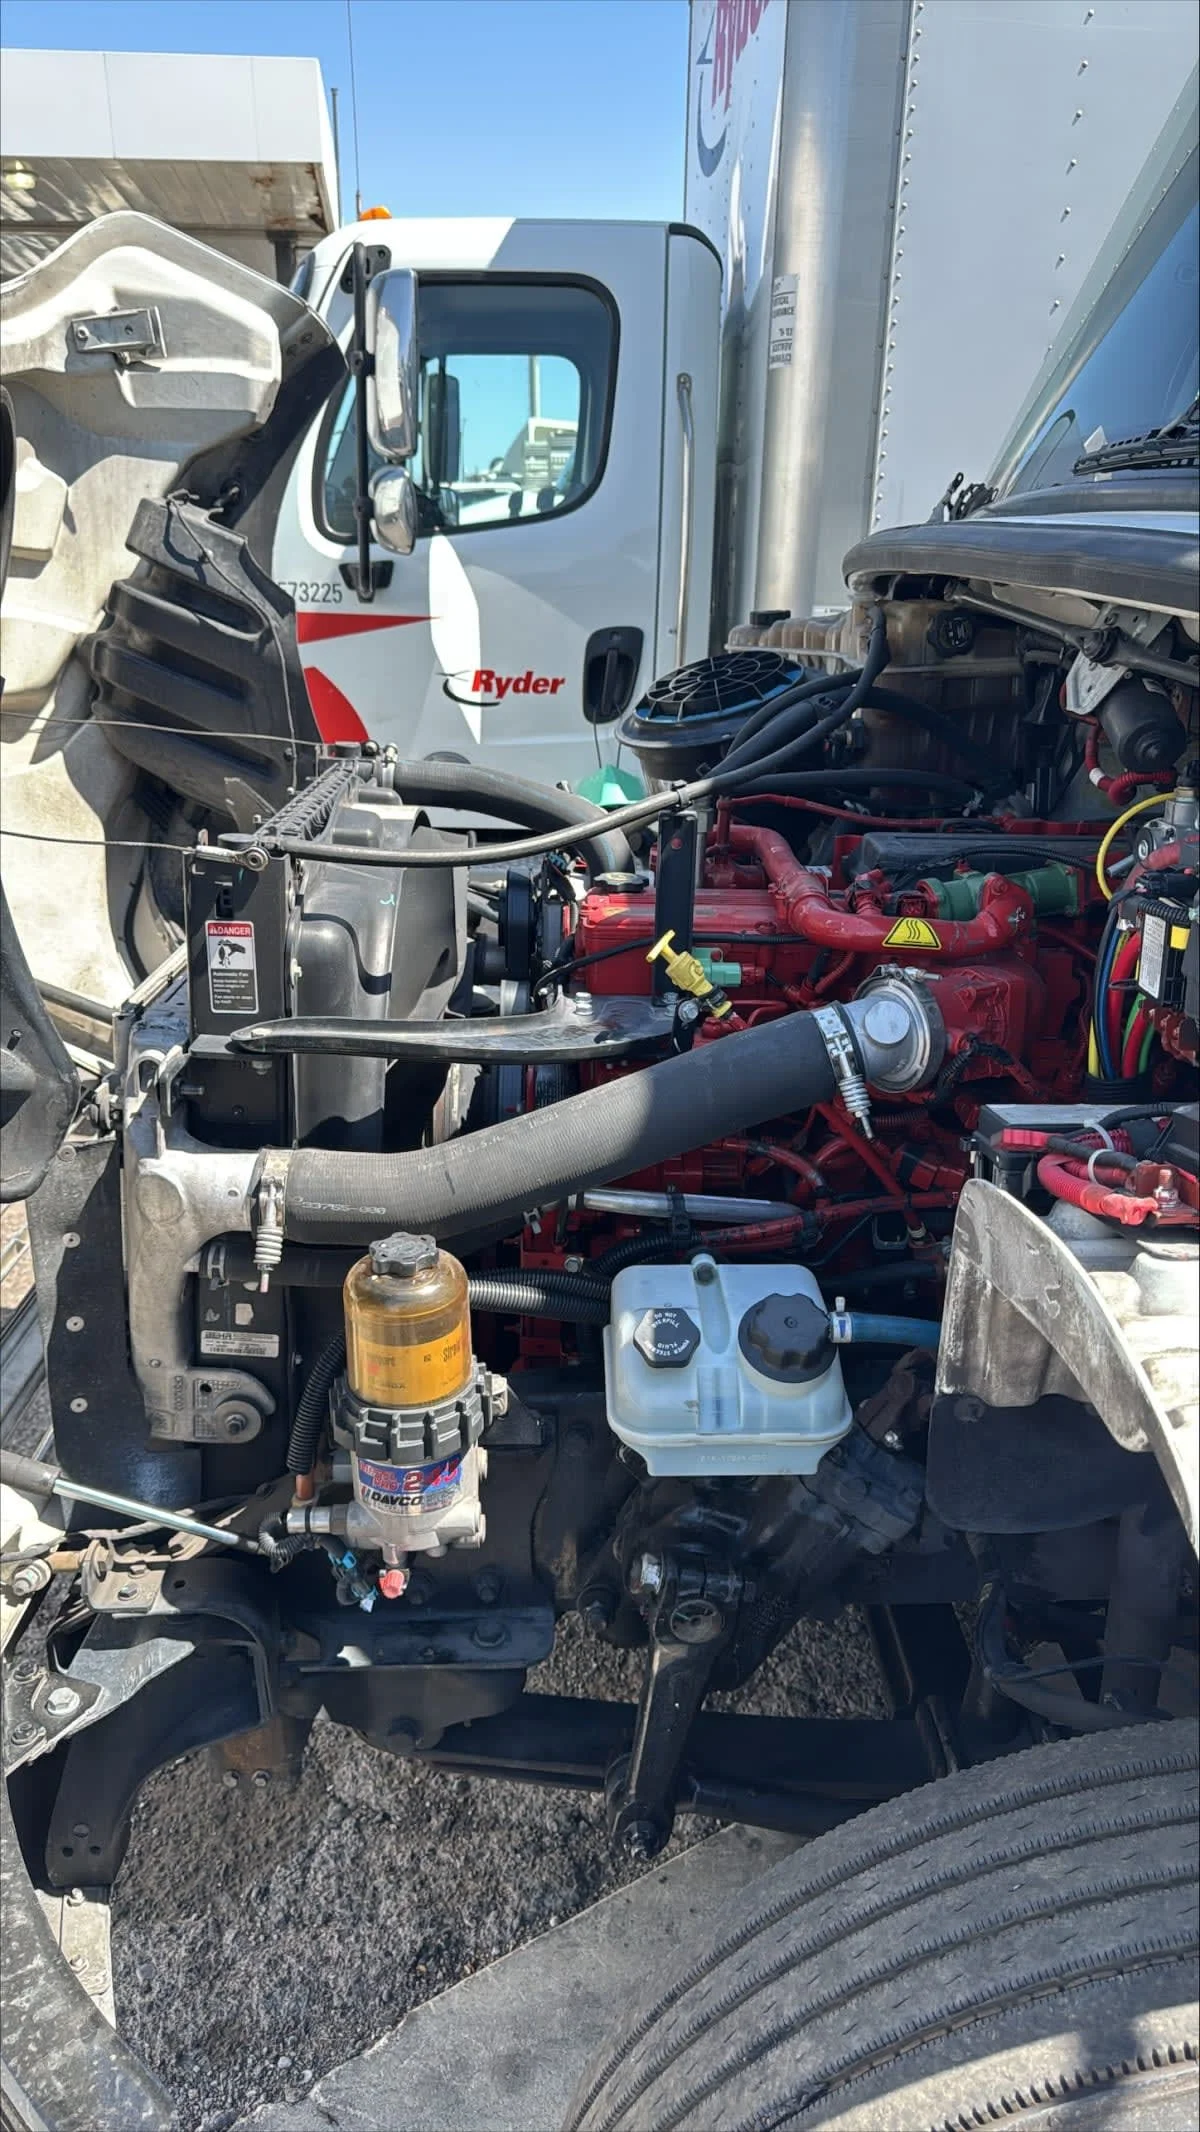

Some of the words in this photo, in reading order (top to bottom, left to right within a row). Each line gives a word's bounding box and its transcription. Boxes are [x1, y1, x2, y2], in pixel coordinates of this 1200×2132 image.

[471, 669, 566, 699] Ryder
[217, 926, 251, 936] DANGER
[370, 1491, 423, 1506] DAVCO
